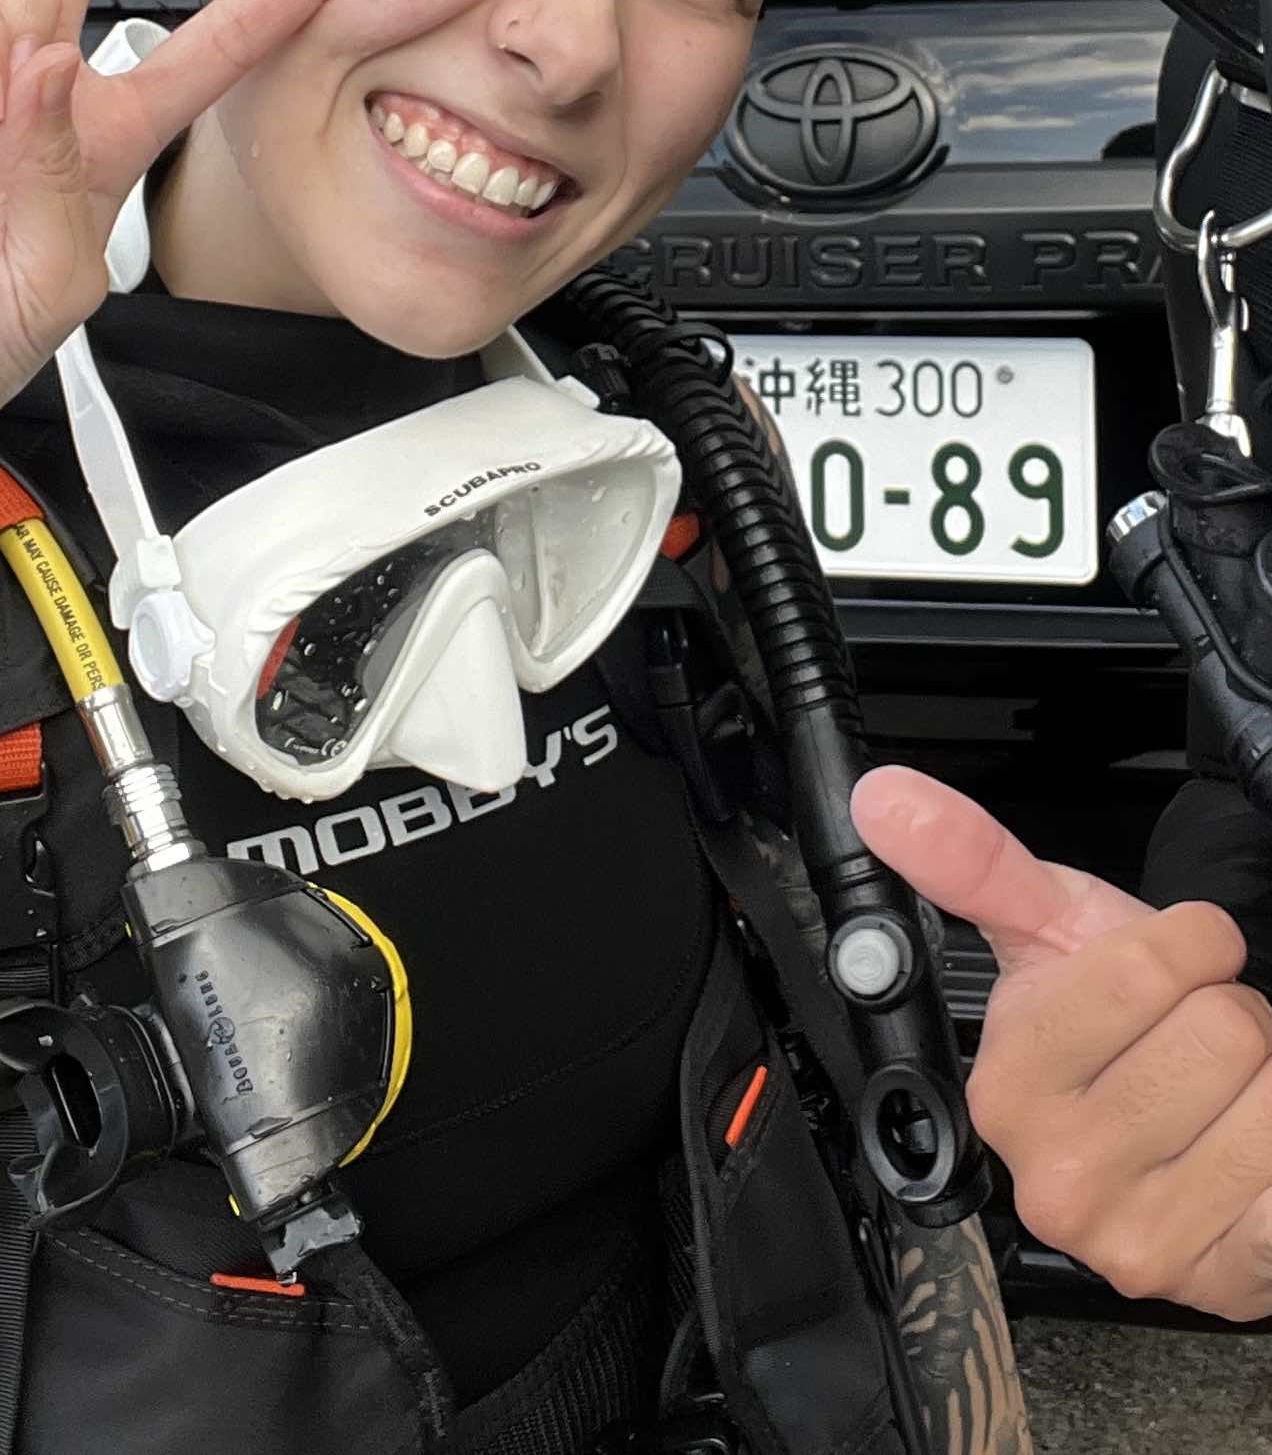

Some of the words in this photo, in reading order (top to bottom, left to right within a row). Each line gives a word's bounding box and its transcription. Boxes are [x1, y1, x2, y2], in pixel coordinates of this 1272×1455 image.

[423, 461, 542, 517] SCUBAPRO
[24, 538, 43, 561] MAY
[36, 560, 63, 596] CAUSE
[54, 596, 86, 643] DAMAGE
[76, 643, 92, 662] OR
